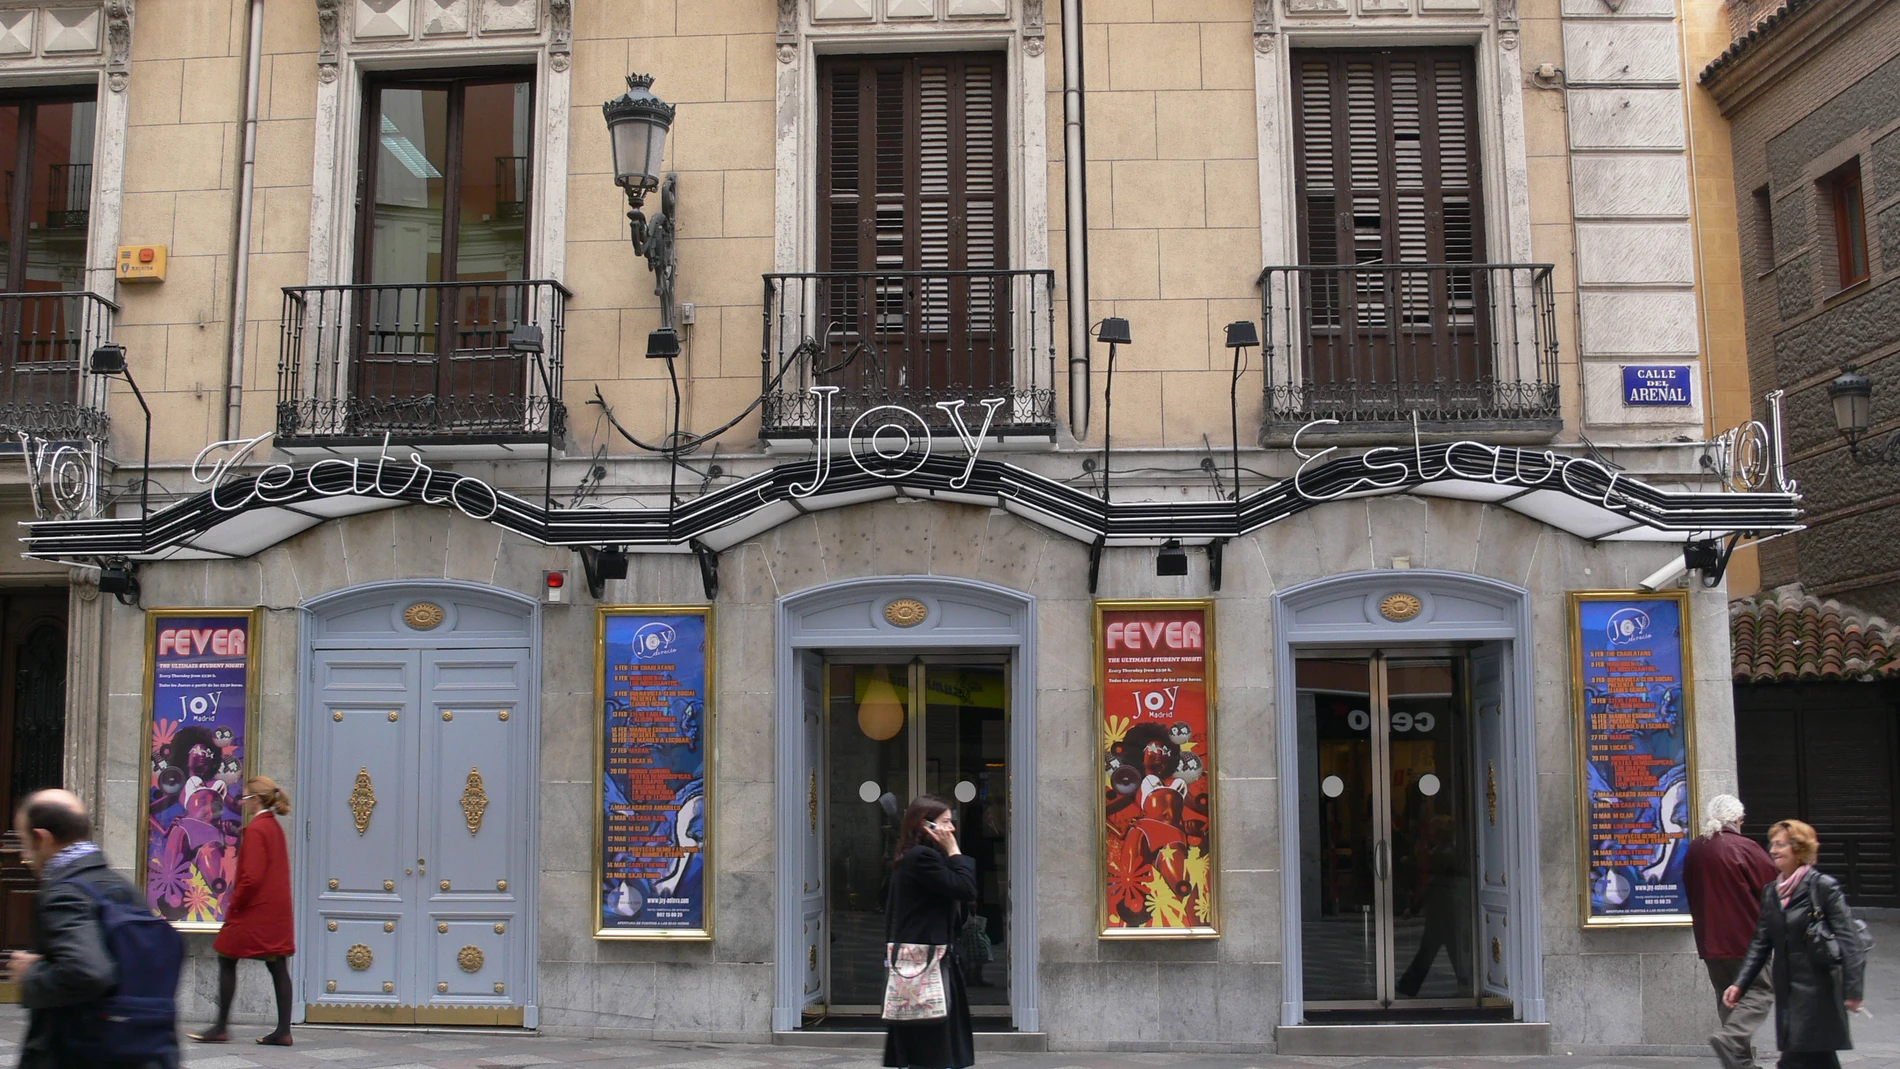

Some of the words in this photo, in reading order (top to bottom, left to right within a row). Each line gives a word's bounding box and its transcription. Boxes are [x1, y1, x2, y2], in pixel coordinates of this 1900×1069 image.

[1637, 369, 1676, 379] CALLE
[1629, 387, 1686, 402] ARENAL
[1291, 409, 1627, 510] Eslava
[191, 430, 499, 520] Teatro
[159, 628, 246, 656] FEVER
[1107, 621, 1201, 649] FEVER
